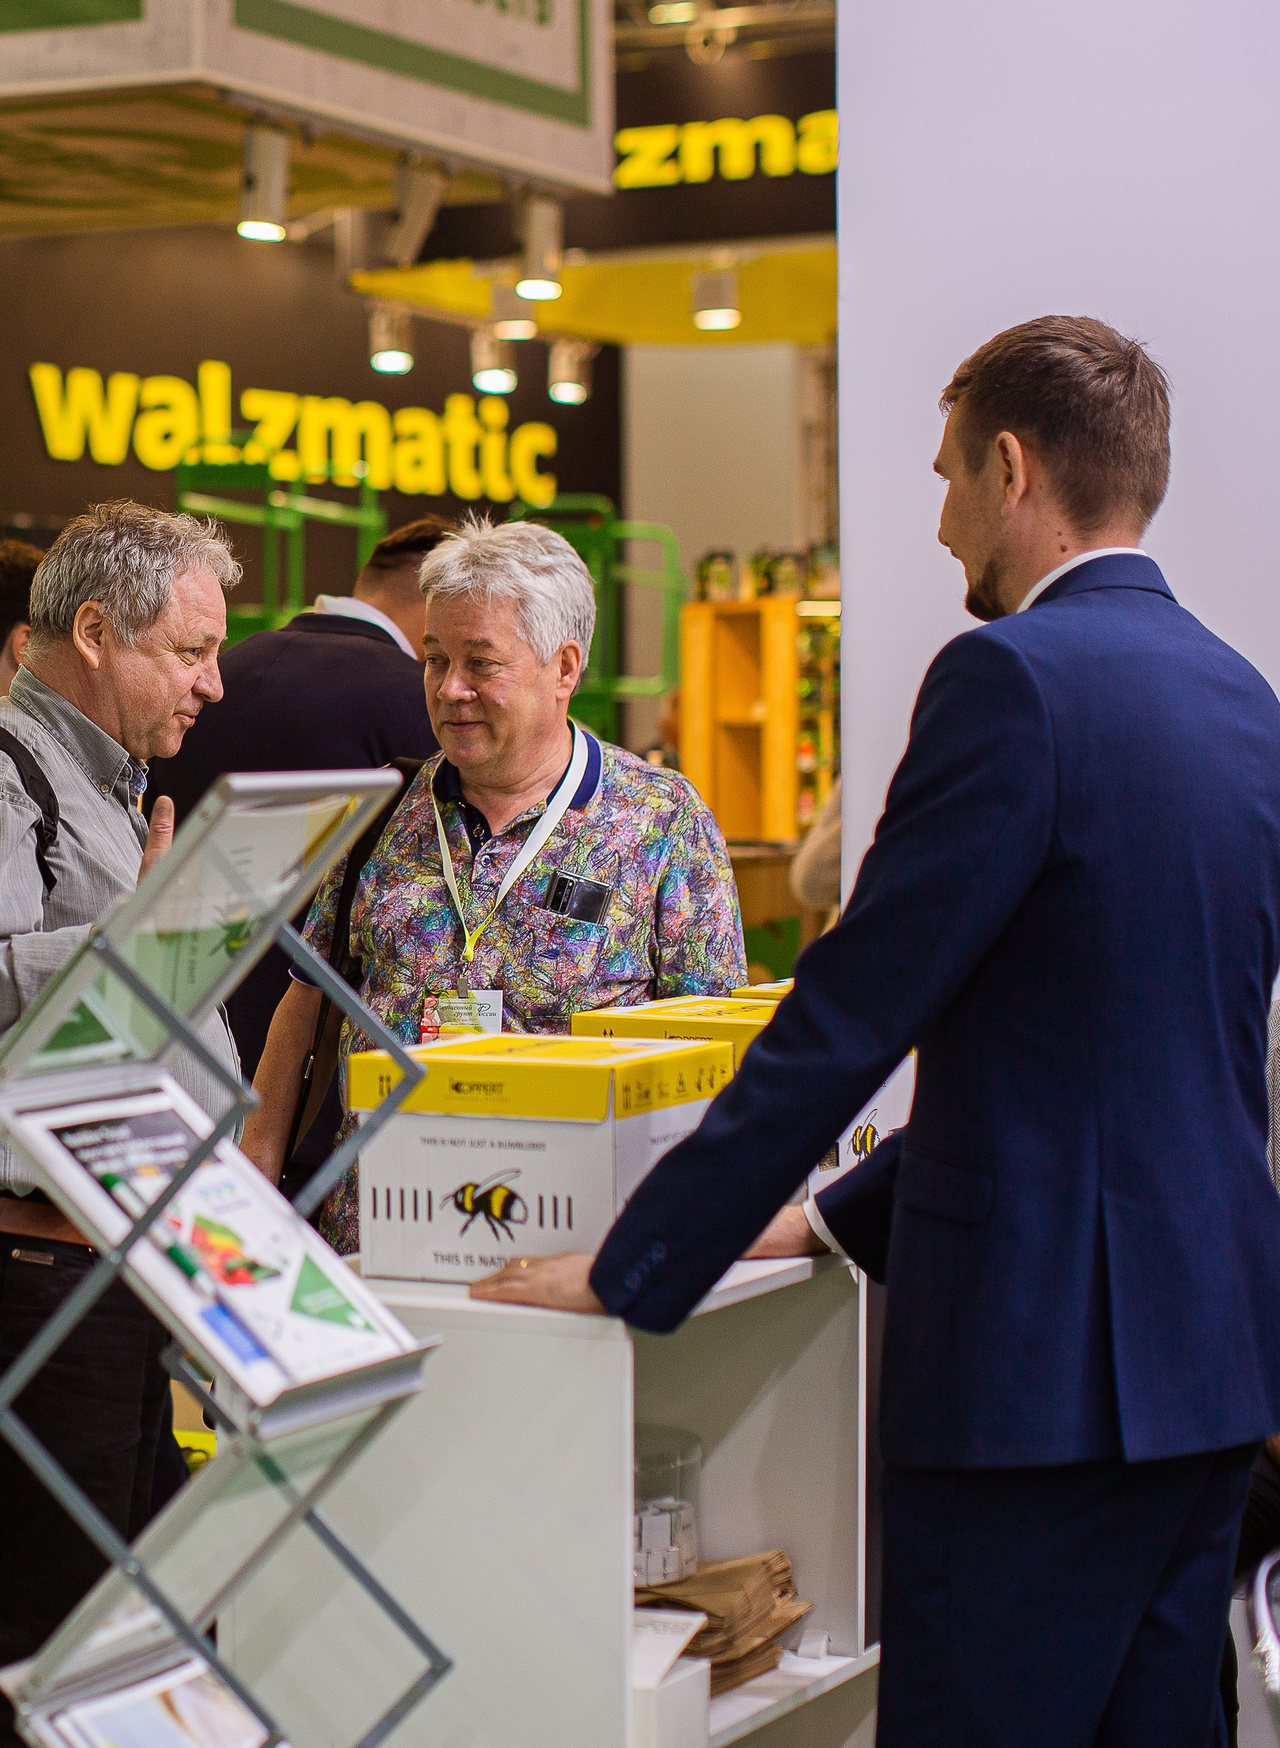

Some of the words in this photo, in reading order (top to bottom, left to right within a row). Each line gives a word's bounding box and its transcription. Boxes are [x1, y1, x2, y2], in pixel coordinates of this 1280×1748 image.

[29, 359, 558, 508] walzmatic
[419, 1135, 437, 1147] THIS
[449, 1137, 466, 1148] NOT
[469, 1138, 487, 1149] JUST
[433, 1251, 460, 1265] THIS
[464, 1253, 475, 1266] IS
